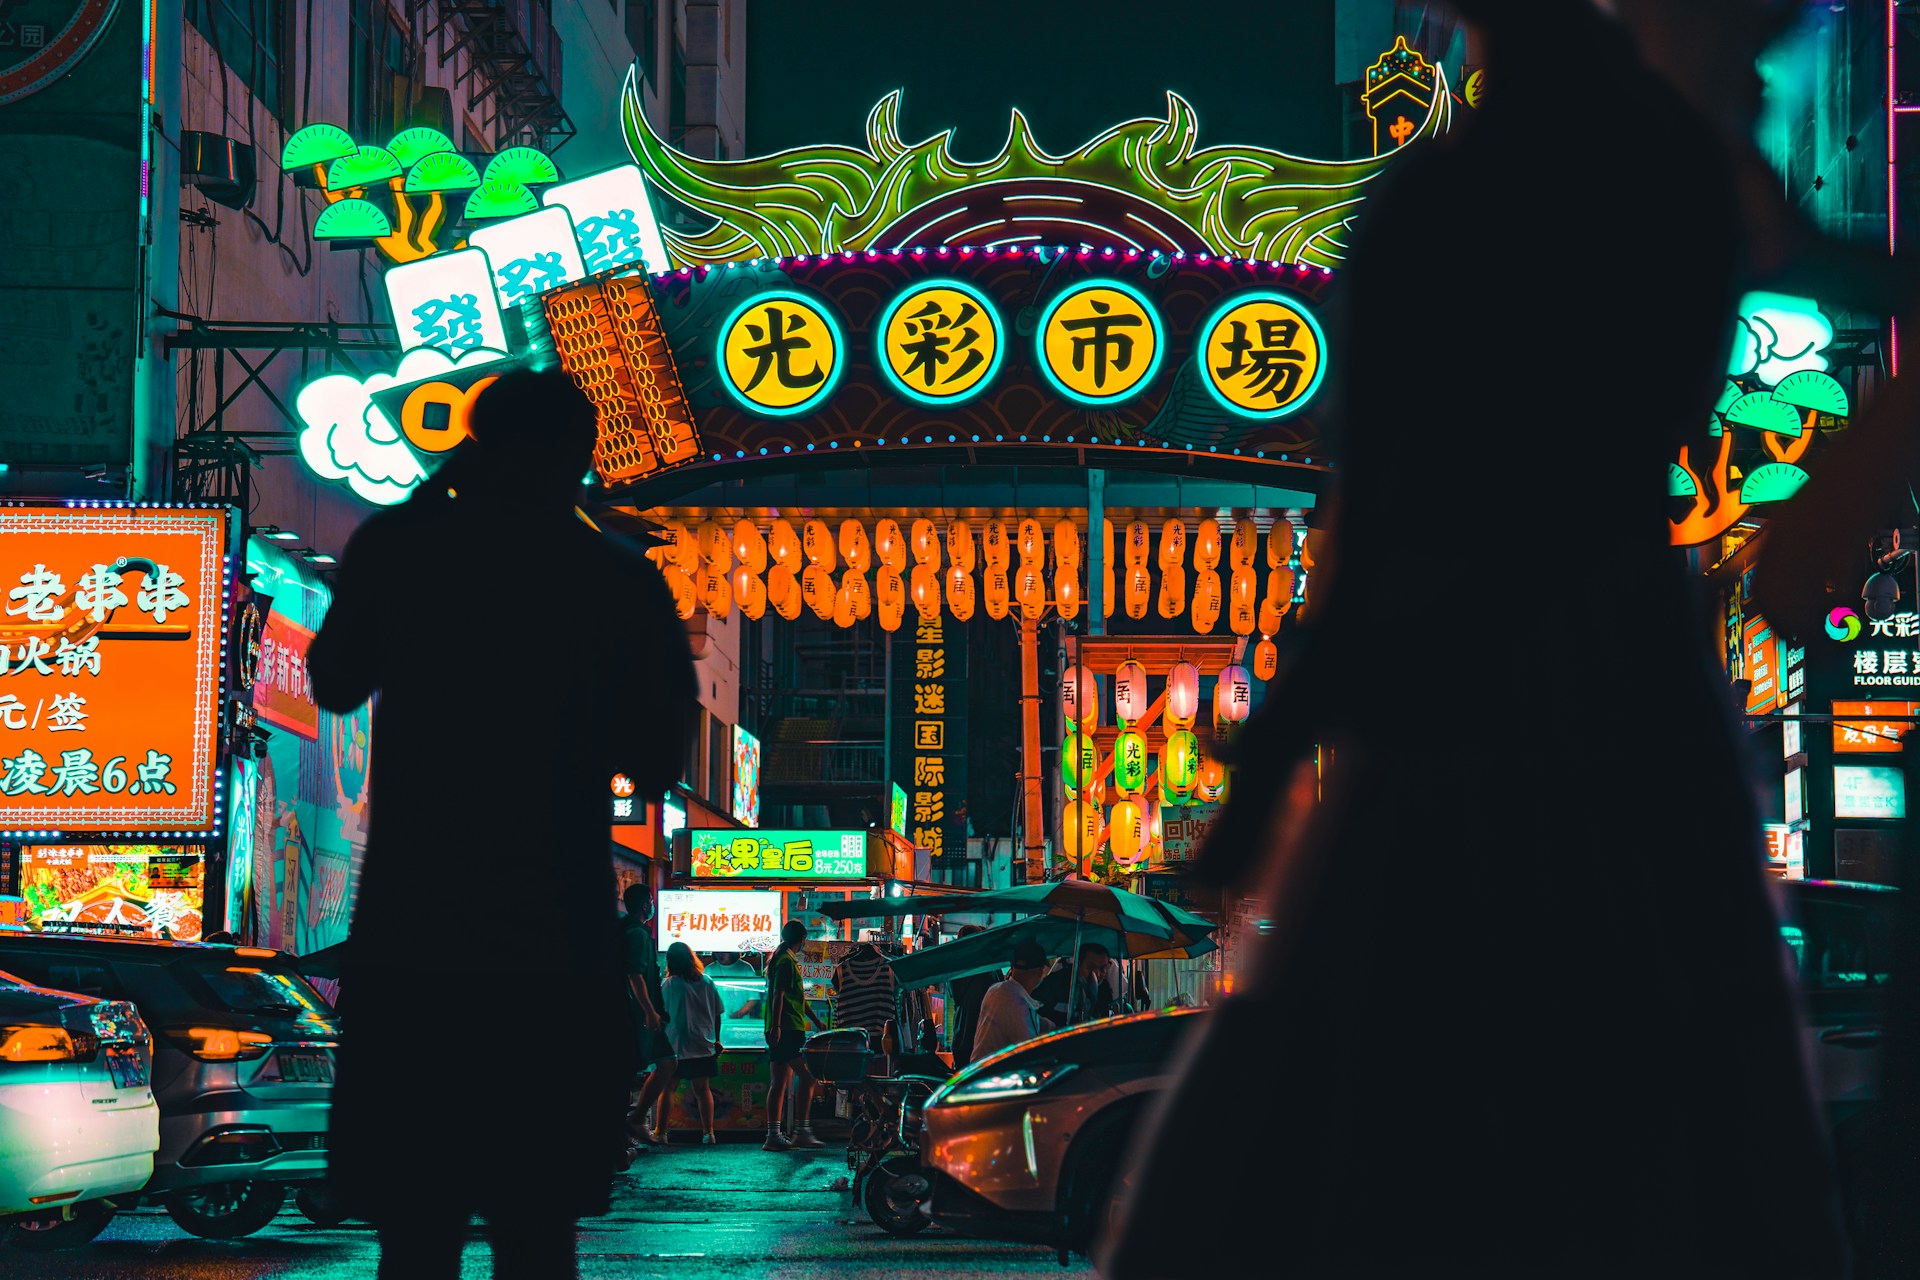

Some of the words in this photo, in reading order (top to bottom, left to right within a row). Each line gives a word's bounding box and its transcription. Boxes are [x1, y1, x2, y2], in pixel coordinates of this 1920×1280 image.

[1389, 116, 1415, 146] 中
[412, 293, 483, 357] 發
[742, 299, 1307, 405] 光彩市場
[806, 525, 815, 547] 光彩
[889, 525, 897, 546] 光彩
[989, 523, 999, 546] 光彩
[1024, 524, 1034, 547] 光彩
[1134, 525, 1143, 546] 光彩
[1173, 525, 1183, 546] 光彩
[1235, 526, 1244, 547] 光彩
[5, 564, 190, 624] 老串串
[1870, 612, 1920, 637] 光彩
[1853, 676, 1892, 686] FLOOR
[0, 692, 88, 733] 元/签
[914, 615, 945, 857] 星影迷国际影城
[1126, 743, 1140, 776] 光彩
[1187, 741, 1198, 774] 光彩
[0, 748, 176, 797] 凌晨6点
[614, 777, 632, 817] 光彩
[706, 838, 813, 871] 水果皇后
[814, 859, 832, 874] 8元
[834, 860, 863, 874] 250克
[667, 913, 772, 932] 厚切炒酸奶
